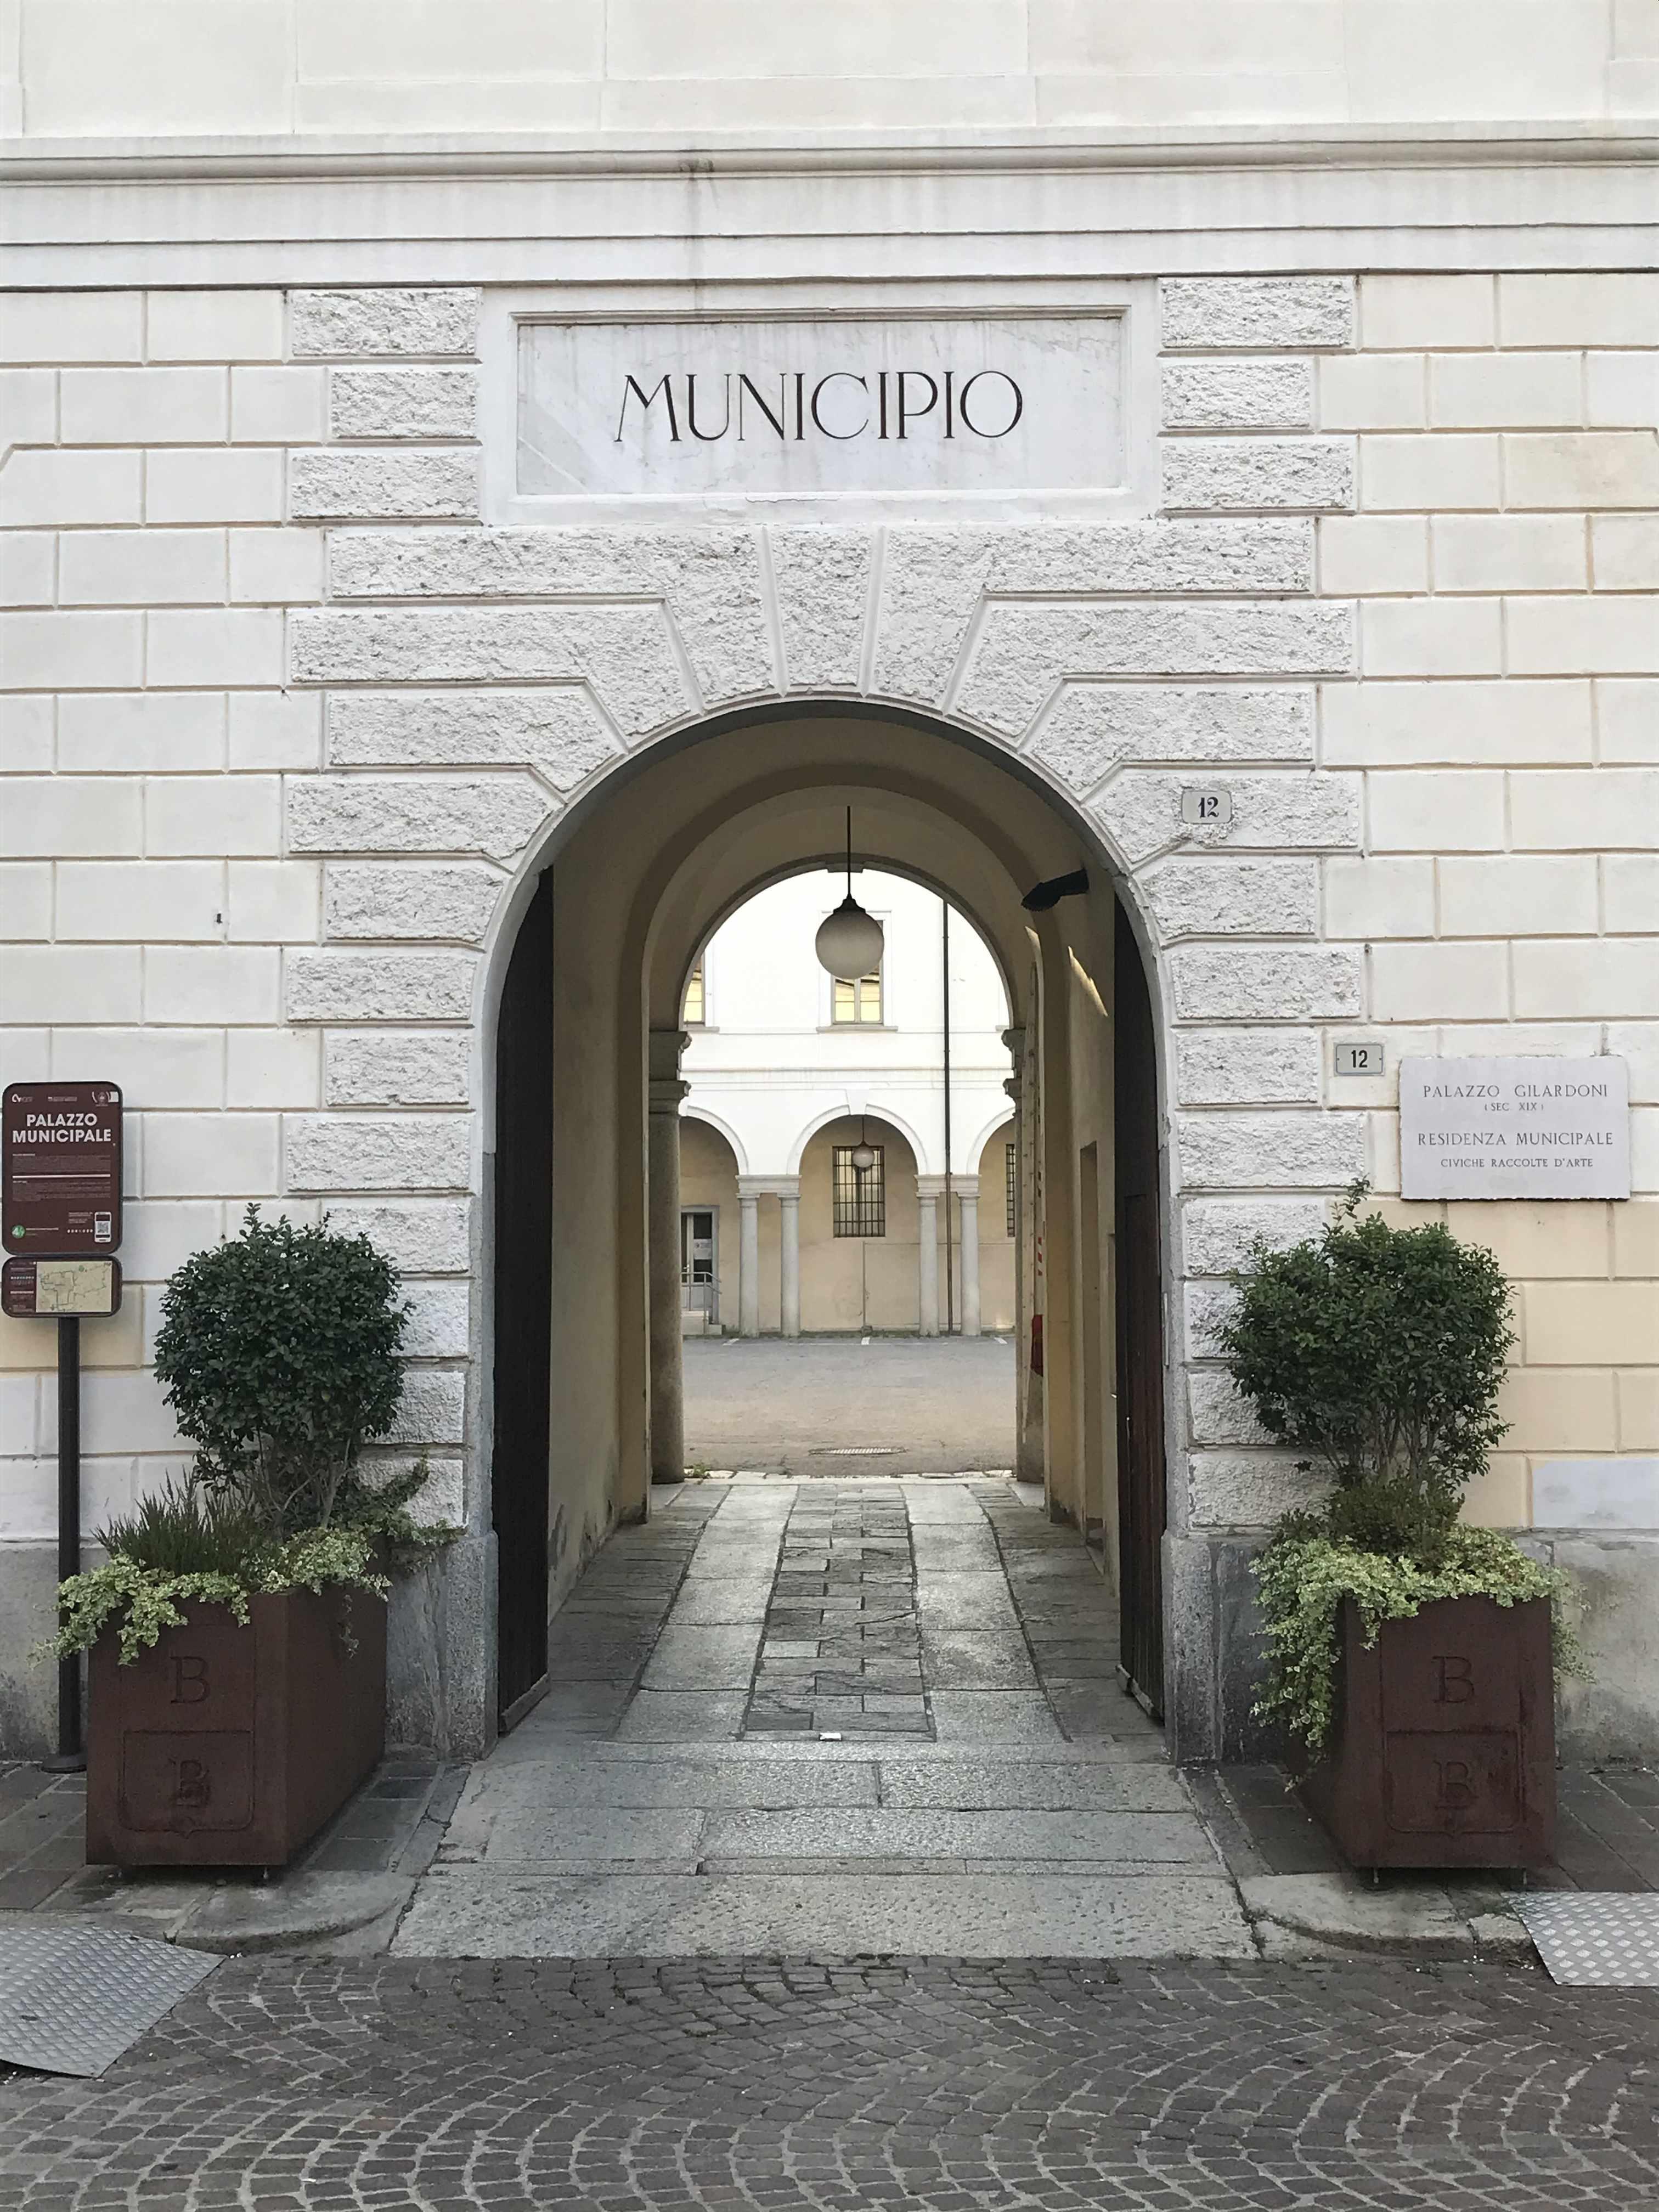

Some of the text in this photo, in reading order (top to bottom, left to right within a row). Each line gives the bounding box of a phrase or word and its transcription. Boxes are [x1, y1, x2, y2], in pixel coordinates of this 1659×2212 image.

[613, 371, 1023, 442] MUNICIPIO
[1198, 797, 1220, 819] 12
[1351, 1049, 1368, 1068] 12
[1423, 1084, 1608, 1098] PALAZZO GILARDONI
[26, 1113, 98, 1127] PALAZZO
[12, 1129, 111, 1143] MUNICIPALE
[1418, 1132, 1613, 1146] RESIDENZA MUNICIPALE
[1441, 1158, 1594, 1168] CIVICHE RACCOLTE D'ARTE
[170, 1656, 211, 1704] B
[1430, 1655, 1476, 1703] B
